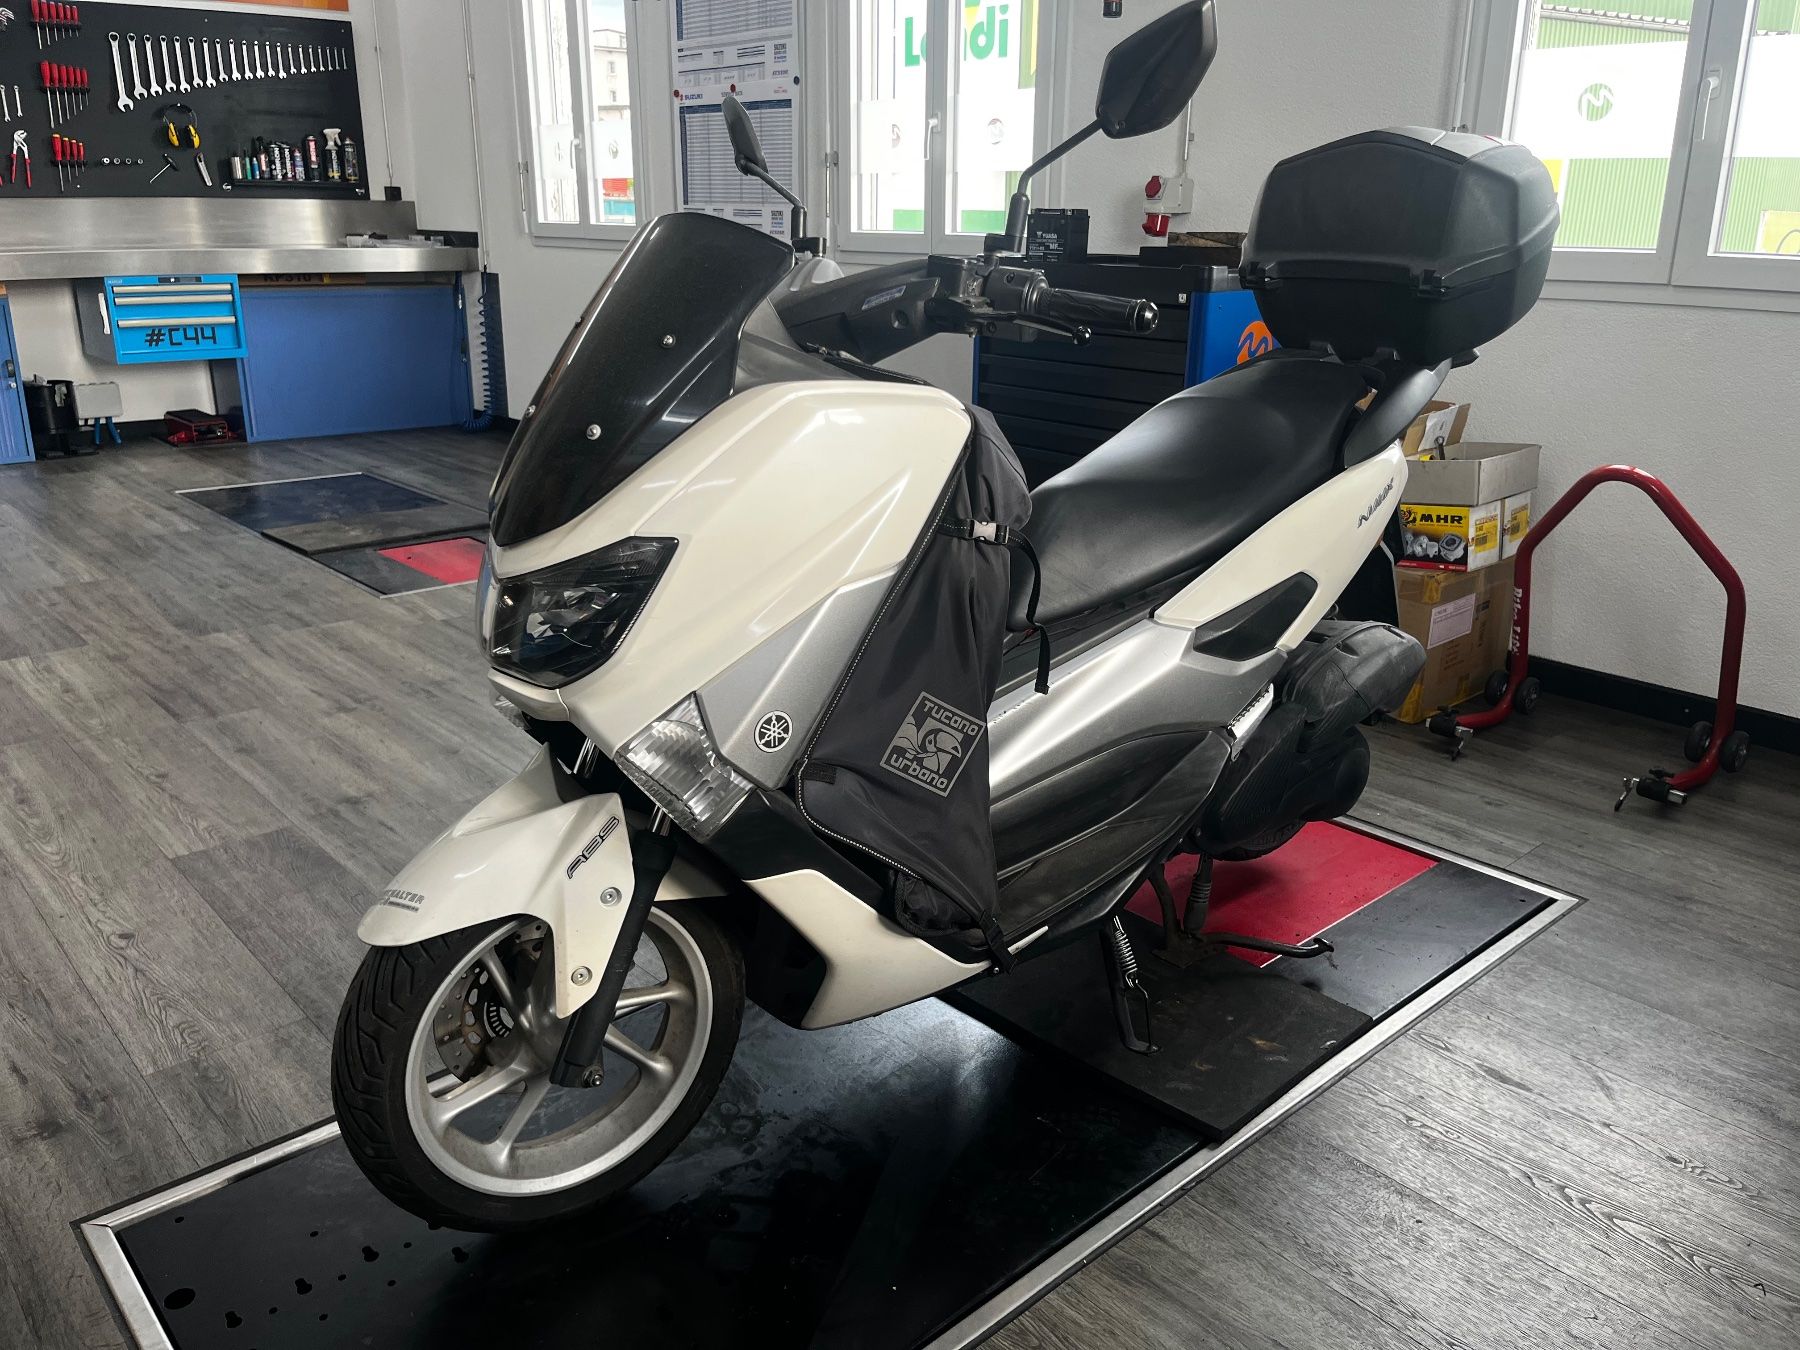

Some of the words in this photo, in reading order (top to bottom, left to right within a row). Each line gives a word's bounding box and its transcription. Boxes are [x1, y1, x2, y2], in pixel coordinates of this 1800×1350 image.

[905, 4, 1009, 67] Ldi
[145, 327, 218, 347] #C44
[1420, 513, 1463, 525] MHR
[567, 816, 620, 880] ABS
